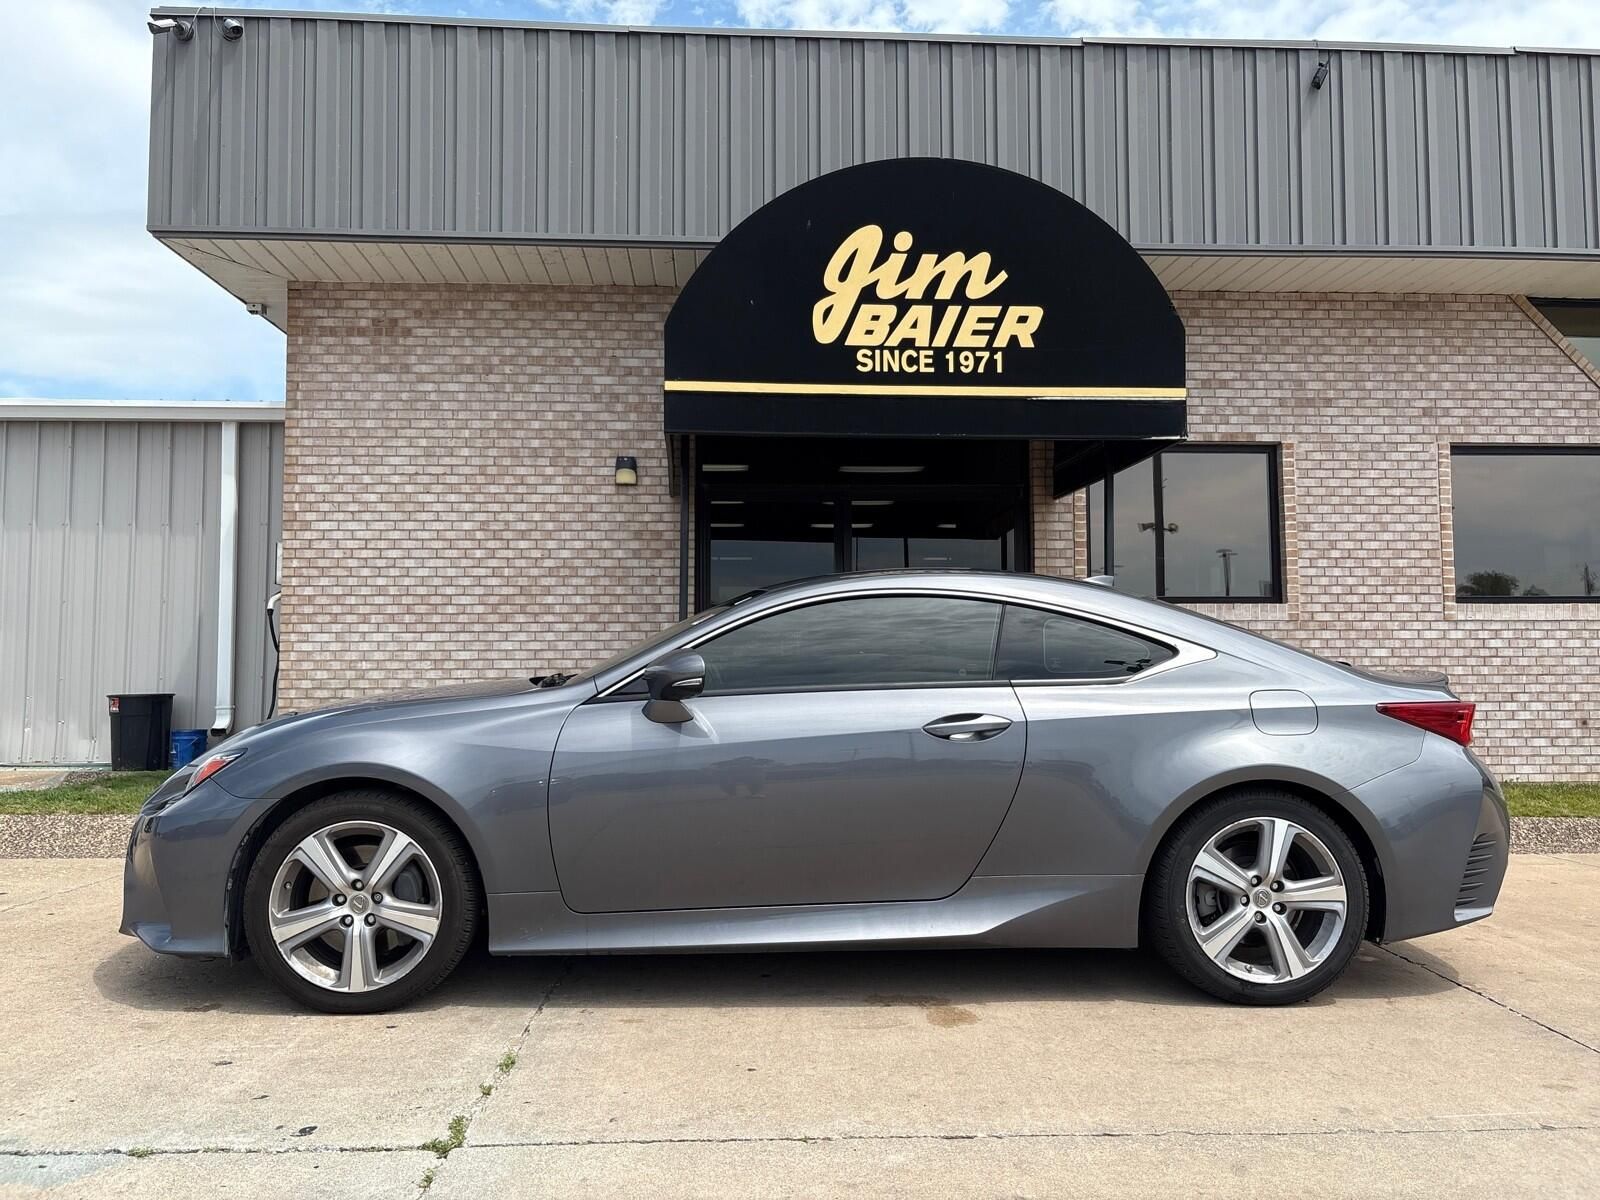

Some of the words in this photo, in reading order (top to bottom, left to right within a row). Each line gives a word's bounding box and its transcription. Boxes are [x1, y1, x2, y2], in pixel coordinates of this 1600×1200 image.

[812, 224, 1009, 345] Jim
[844, 304, 1045, 348] BAIER
[856, 349, 935, 373] SINCE
[945, 351, 1004, 374] 1971
